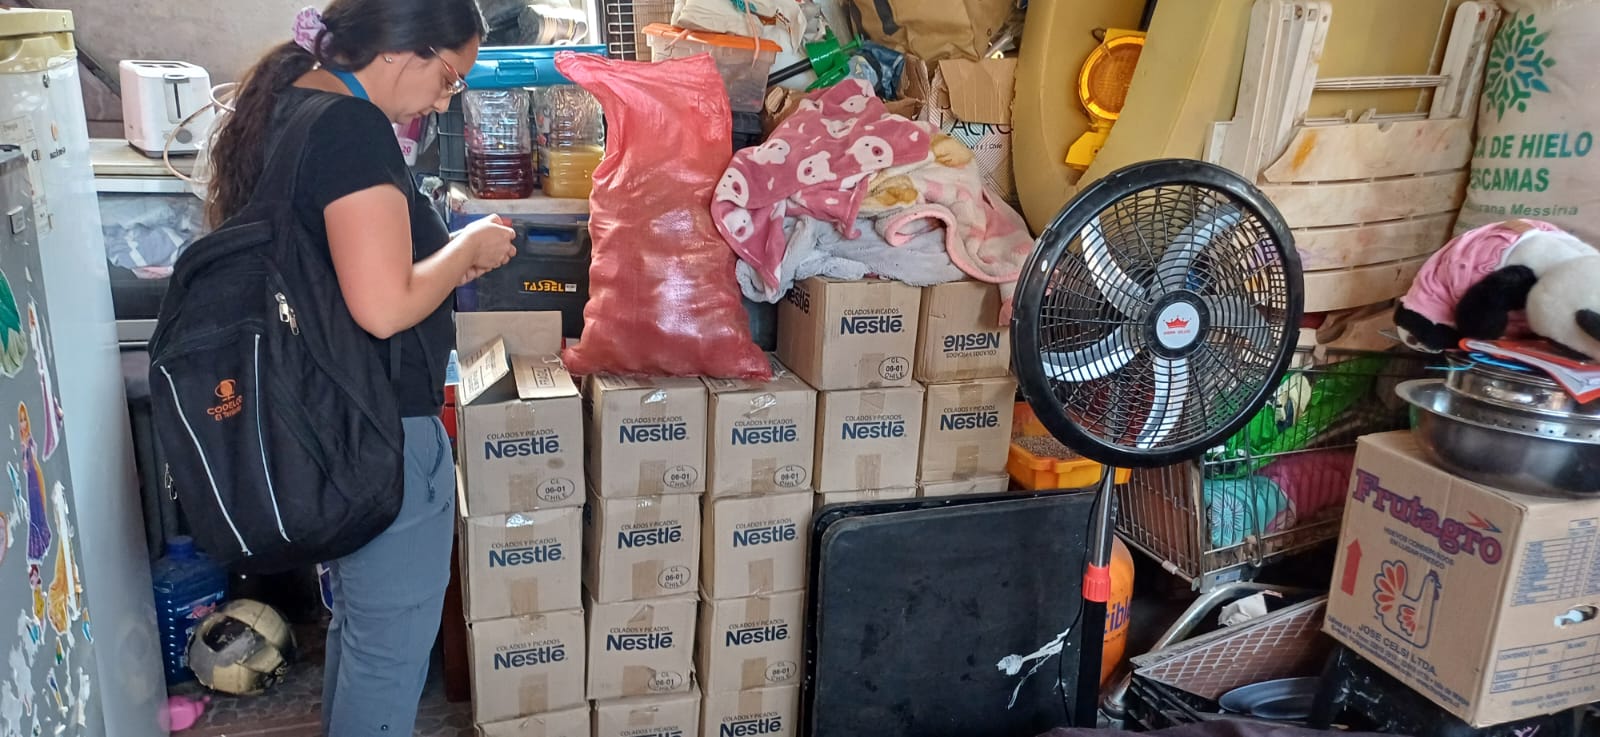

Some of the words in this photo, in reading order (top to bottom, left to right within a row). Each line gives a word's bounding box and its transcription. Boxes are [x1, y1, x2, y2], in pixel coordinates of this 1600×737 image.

[1490, 135, 1514, 158] DE
[1518, 132, 1592, 158] HIELO
[1511, 204, 1578, 216] Messina
[524, 280, 564, 292] TASBEL
[841, 315, 903, 335] Nestlé
[943, 332, 1000, 352] Nestlé
[842, 420, 905, 440] Nestlé
[940, 411, 999, 430] Nestlé
[487, 432, 518, 440] COLADOS
[620, 422, 686, 444] Nestlé
[732, 424, 796, 445] Nestlé
[485, 435, 560, 460] Nestlé
[1352, 468, 1503, 565] Frutagro
[618, 526, 682, 549] Nestlé
[734, 524, 796, 547] Nestlé
[489, 544, 562, 568] Nestlé
[532, 639, 560, 647] PICADOS
[606, 632, 673, 651] Nestlé
[726, 624, 788, 647] Nestlé
[1359, 624, 1382, 642] JOSE
[1383, 638, 1409, 658] CELSI
[494, 644, 565, 670] Nestlé
[720, 717, 781, 737] Nestlé
